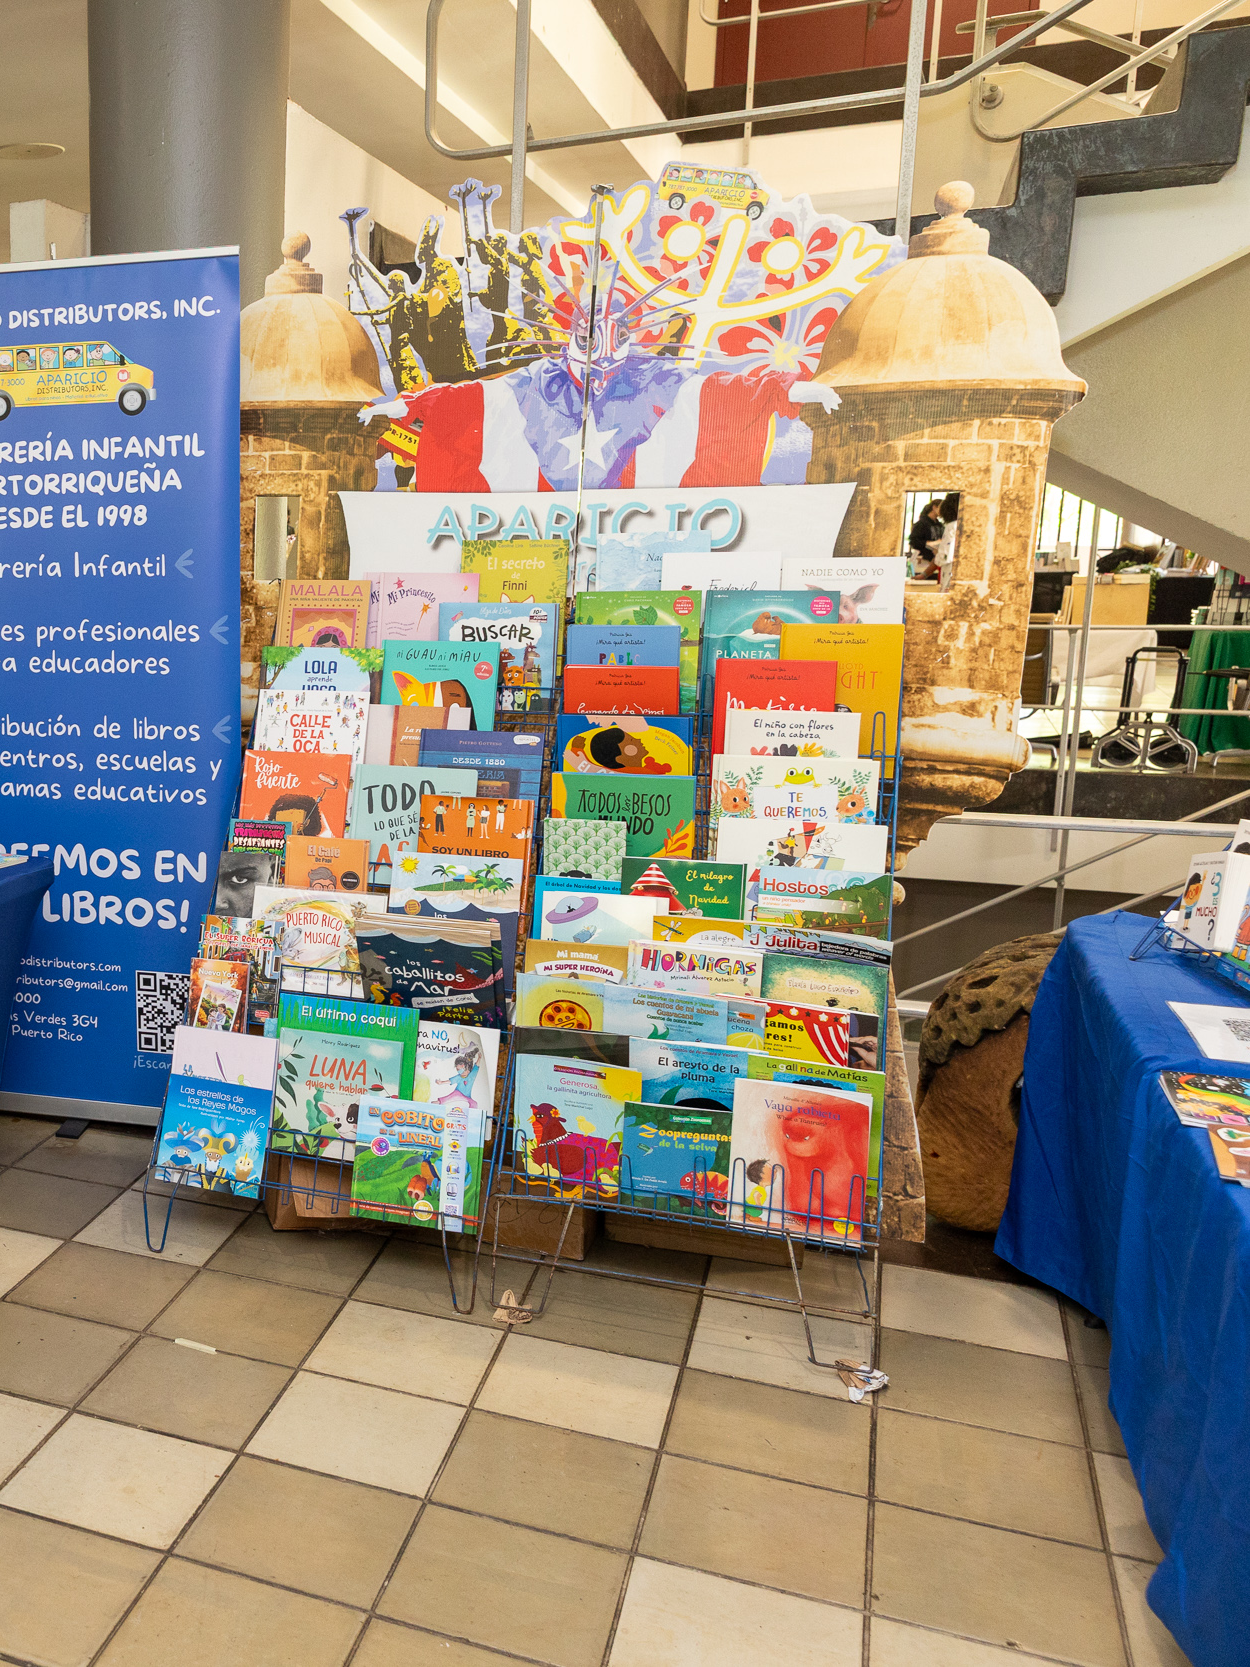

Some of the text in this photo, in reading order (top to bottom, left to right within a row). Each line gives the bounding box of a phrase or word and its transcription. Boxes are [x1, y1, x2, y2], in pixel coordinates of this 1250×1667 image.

[704, 187, 745, 197] APARICIO
[9, 301, 167, 329] DISTRIBUTORS,
[174, 296, 220, 317] INC.
[37, 370, 107, 386] APARICIO
[82, 433, 205, 461] INFANTIL
[61, 504, 89, 527] EL
[97, 505, 148, 527] 1998
[426, 498, 741, 549] APARICIO
[74, 551, 166, 577] Infantil
[487, 557, 545, 570] El secreto
[801, 568, 884, 577] NADIE COMO YO
[290, 585, 363, 596] MALALA
[503, 581, 527, 590] Finni
[36, 619, 200, 647] profesionales
[461, 624, 534, 642] BUSCAR
[832, 638, 843, 646] qué
[29, 650, 170, 675] educadores
[305, 661, 337, 674] LOLA
[93, 716, 121, 739] de
[133, 717, 200, 741] libros
[290, 714, 332, 728] CALLE
[754, 719, 834, 731] El niño con flores
[293, 729, 324, 739] DE LA
[293, 740, 321, 753] OCA
[96, 751, 196, 774] escuelas
[210, 759, 222, 781] y
[255, 756, 283, 775] Rojo
[255, 772, 301, 789] fuerte
[74, 778, 207, 806] educativos
[788, 792, 803, 803] TE
[764, 806, 828, 819] QUEREMOS,
[390, 827, 416, 841] DE LA
[233, 837, 285, 849] DESAFIANTES
[307, 845, 340, 858] El Café
[432, 846, 509, 859] SOY UN LIBRO
[154, 850, 206, 882] EN
[686, 870, 734, 884] El milagro
[704, 883, 715, 891] de
[763, 878, 829, 896] Hostos
[689, 894, 729, 908] Navidad
[42, 890, 190, 934] LIBROS!
[1195, 906, 1218, 918] MUCHO
[286, 912, 343, 932] PUERTO RICO
[304, 931, 341, 948] MUSICAL
[711, 934, 736, 944] alegre
[199, 968, 239, 979] Nueva York
[384, 966, 465, 982] caballitos
[24, 1010, 66, 1025] Verdes
[72, 1015, 98, 1028] 3G4
[302, 1005, 397, 1028] El último coquí
[12, 1025, 83, 1041] Puerto Rico
[309, 1054, 367, 1086] LUNA
[658, 1056, 740, 1074] El areyto de la
[681, 1071, 715, 1084] pluma
[180, 1085, 244, 1104] Las estrellas de
[305, 1080, 368, 1095] quiere hablar
[188, 1096, 200, 1106] los
[202, 1098, 226, 1111] Reyes
[227, 1101, 257, 1116] Magos
[764, 1098, 841, 1121] Vaya rabieta
[638, 1124, 732, 1143] Zoopreguntas
